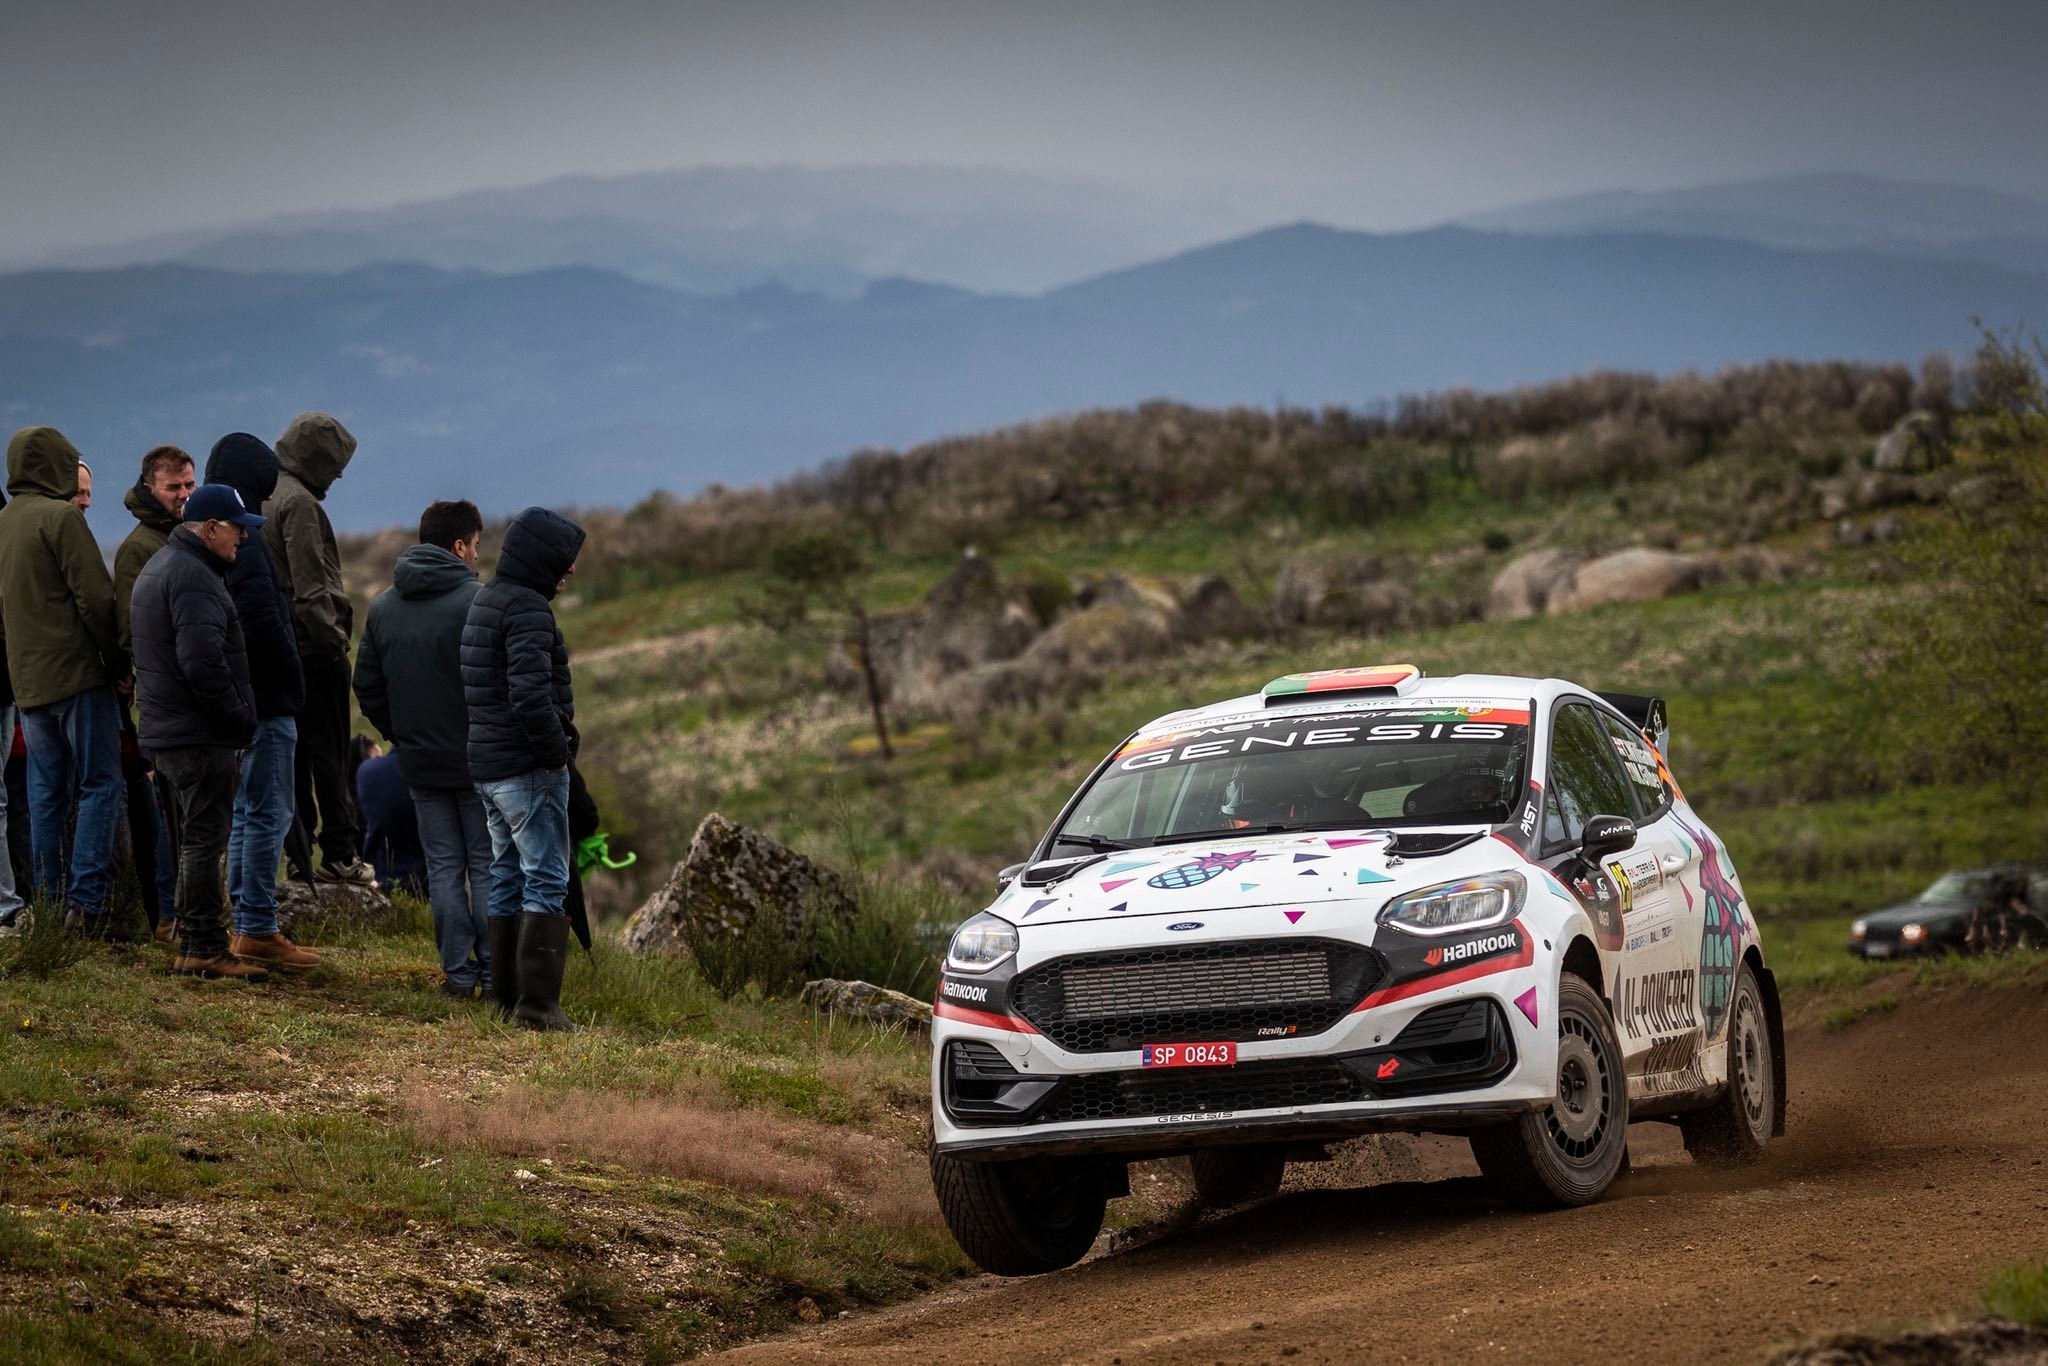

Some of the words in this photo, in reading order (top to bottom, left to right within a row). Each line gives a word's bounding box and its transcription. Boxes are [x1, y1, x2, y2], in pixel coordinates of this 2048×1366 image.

[1292, 711, 1386, 724] TROPHY
[1120, 723, 1508, 770] GENESIS
[1600, 825, 1632, 837] MMR
[1624, 968, 1698, 1040] AI-POWERED
[1257, 1025, 1297, 1036] Rally3
[1154, 1048, 1176, 1064] SP
[1184, 1045, 1229, 1063] 0843
[1157, 1112, 1234, 1124] GENESIS
